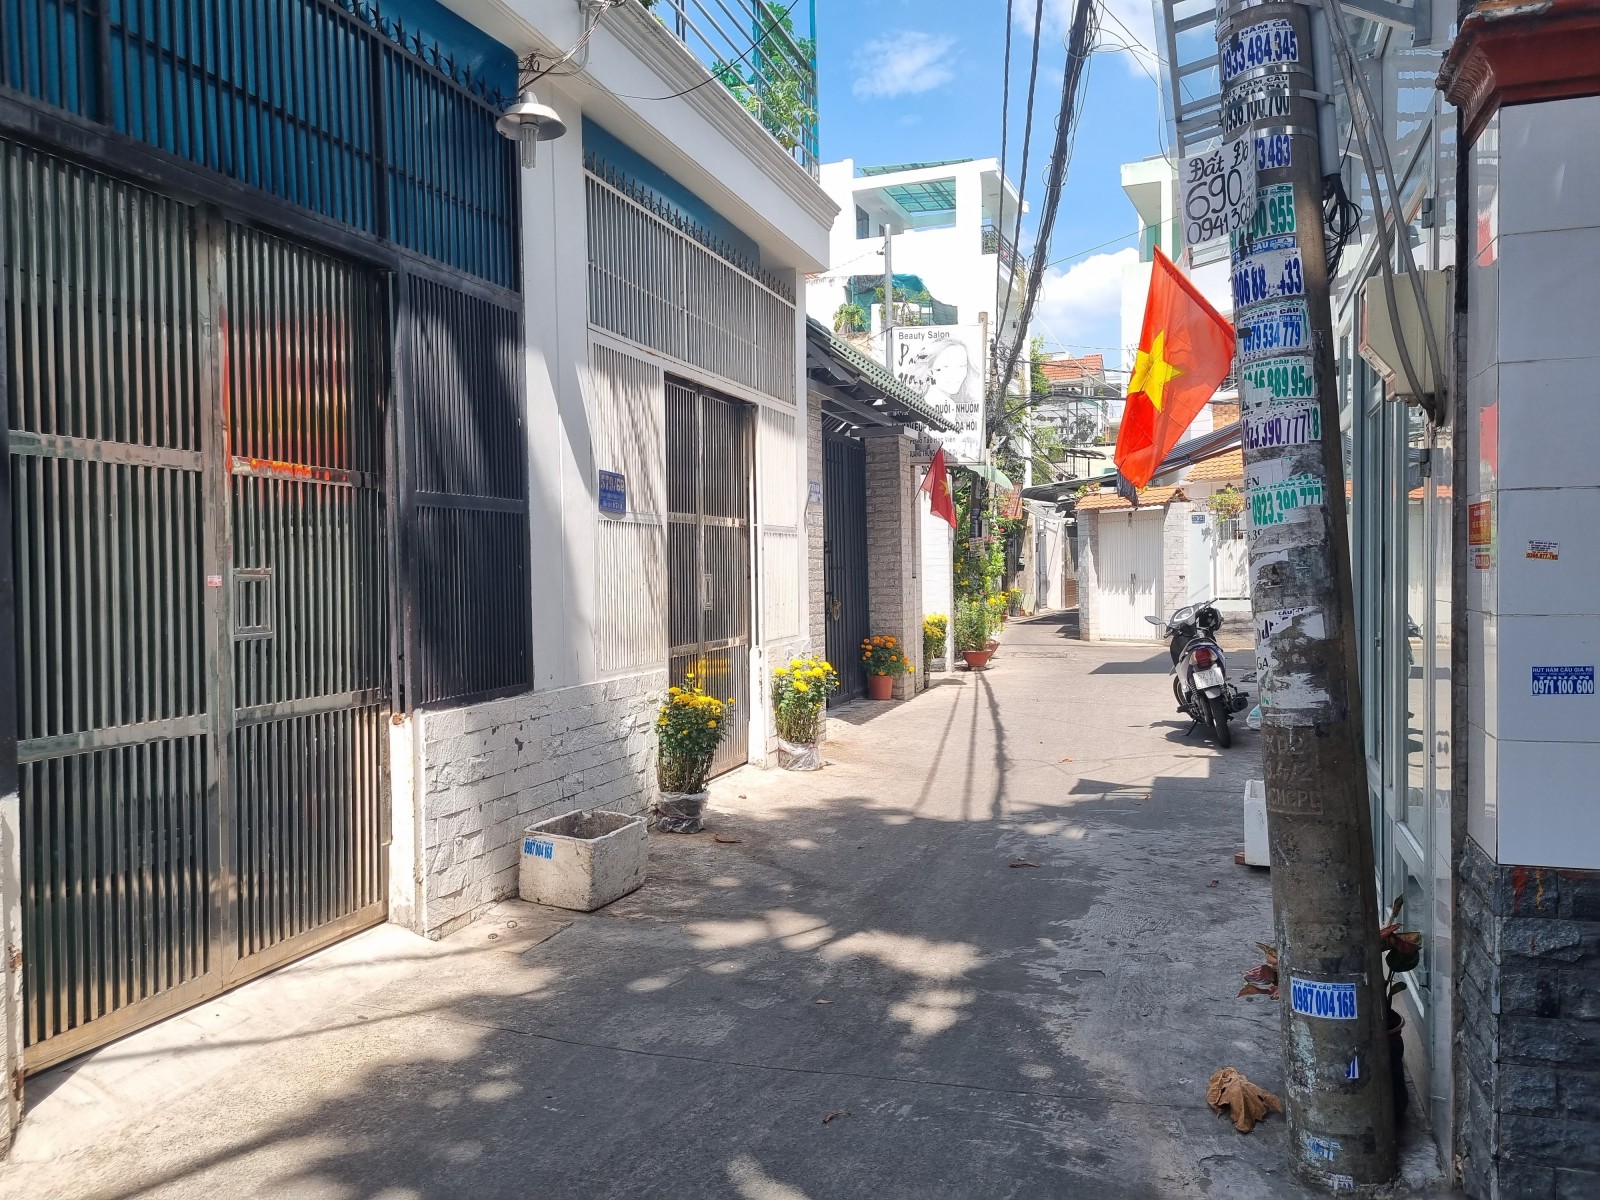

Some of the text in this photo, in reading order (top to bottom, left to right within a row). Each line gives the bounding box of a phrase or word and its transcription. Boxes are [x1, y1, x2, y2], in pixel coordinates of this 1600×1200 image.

[898, 330, 950, 341] Beauty Salon
[1532, 679, 1594, 694] 0971.100.600
